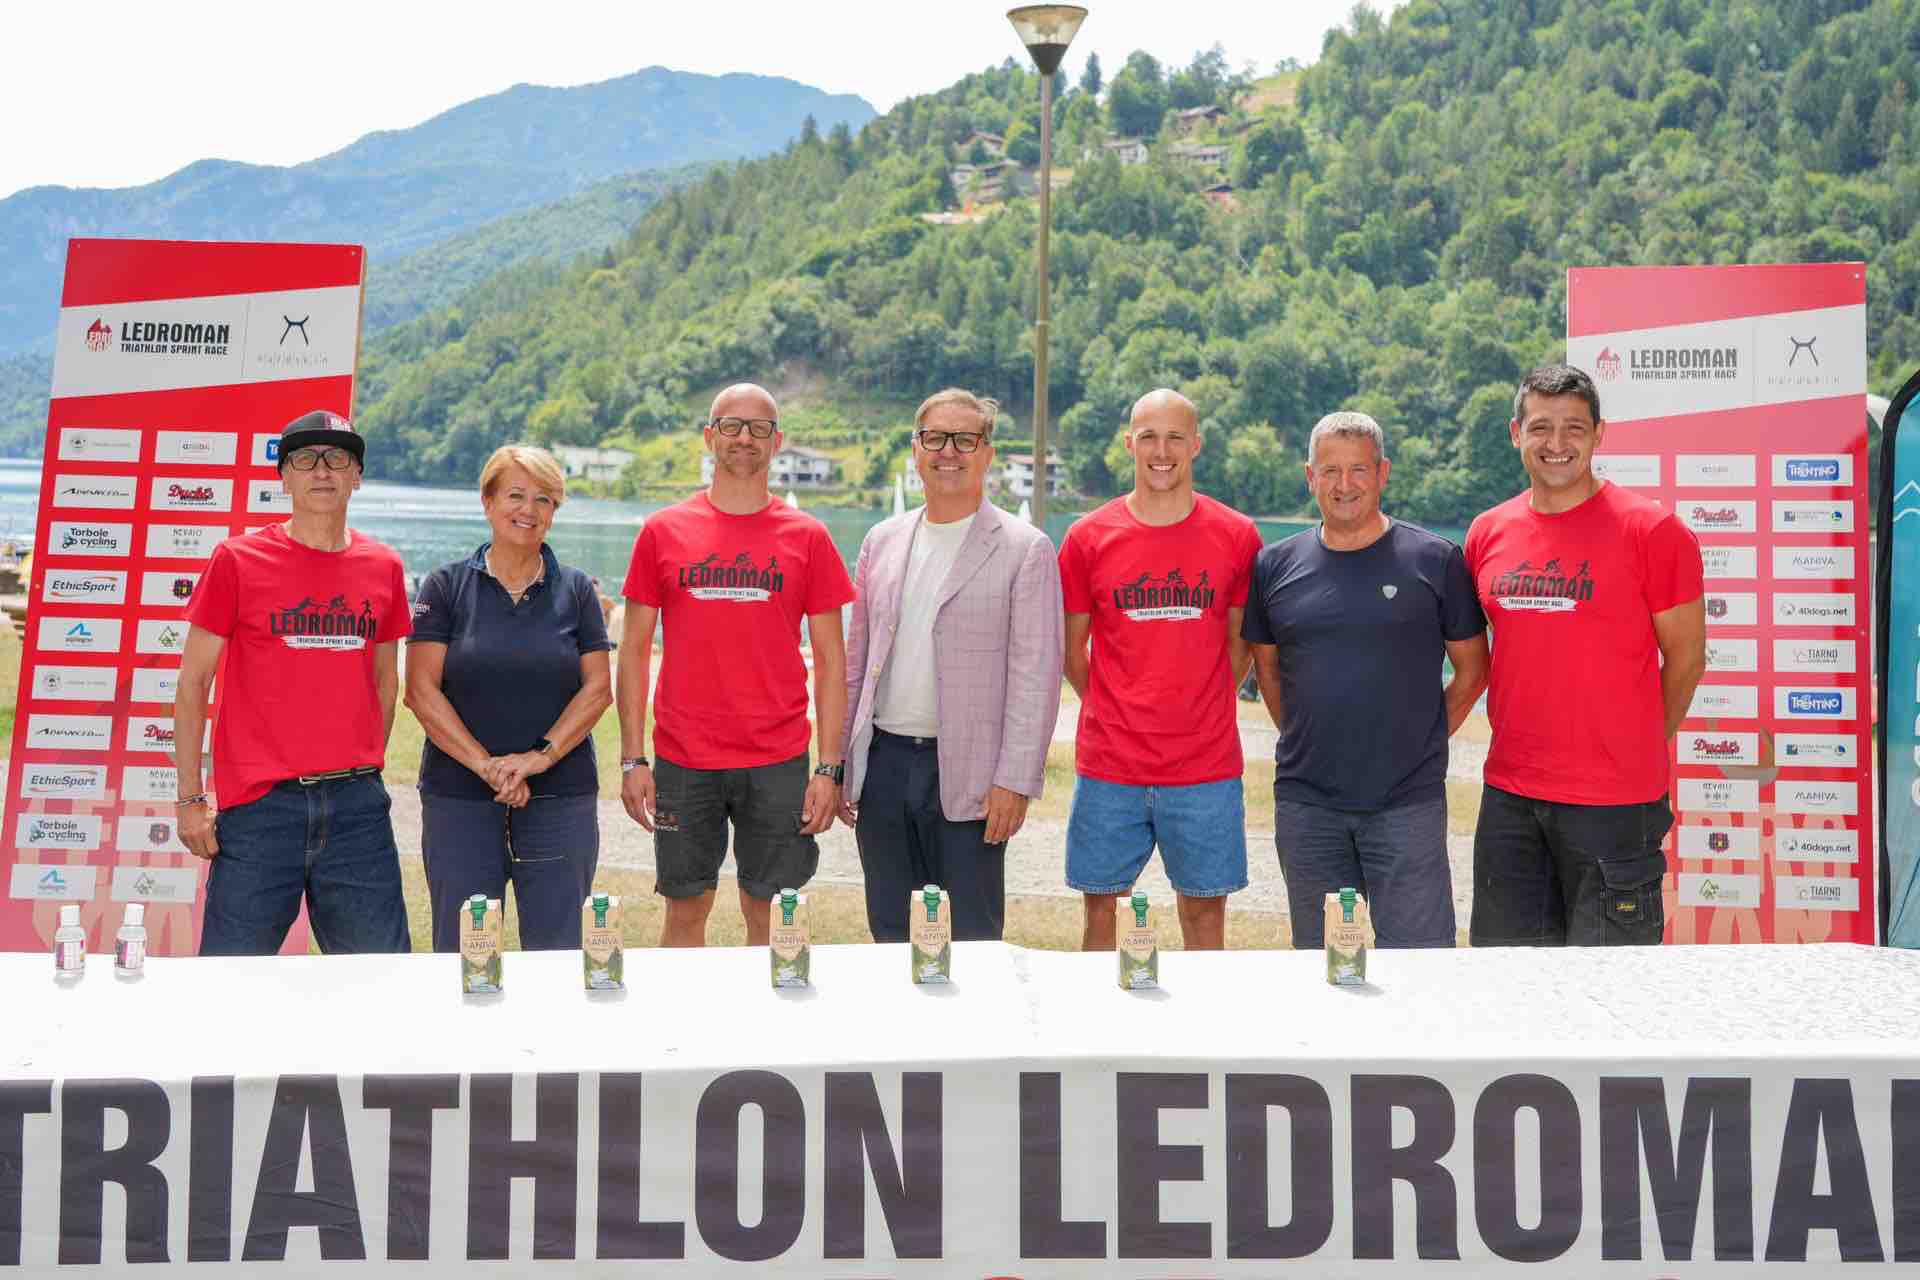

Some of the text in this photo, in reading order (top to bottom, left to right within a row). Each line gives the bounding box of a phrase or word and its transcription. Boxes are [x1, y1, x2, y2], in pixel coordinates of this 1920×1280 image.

[120, 321, 230, 345] LEDROMAN
[120, 343, 229, 356] TRIATHLON SPRINT RACE
[1630, 348, 1738, 369] LEDROMAN
[1631, 368, 1677, 380] TRIATHLON
[1679, 368, 1710, 380] SPRINT
[1713, 368, 1737, 379] RACE
[70, 528, 109, 538] Torbole
[79, 537, 117, 549] cycling
[679, 567, 784, 592] LEDROMAN
[51, 580, 117, 593] EthicSport
[1489, 575, 1595, 601] LEDROMAN
[1112, 585, 1217, 609] LEDROMAN
[1798, 606, 1848, 618] 40dogs.net
[270, 612, 377, 640] LEDROMAN
[1808, 648, 1839, 660] TIARNO
[1791, 695, 1839, 711] TRENTINO
[31, 775, 97, 788] EthicSport
[37, 820, 78, 831] Torbole
[49, 830, 88, 842] cycling
[1801, 842, 1851, 855] 40dogs.net
[1810, 886, 1841, 898] TIARNO
